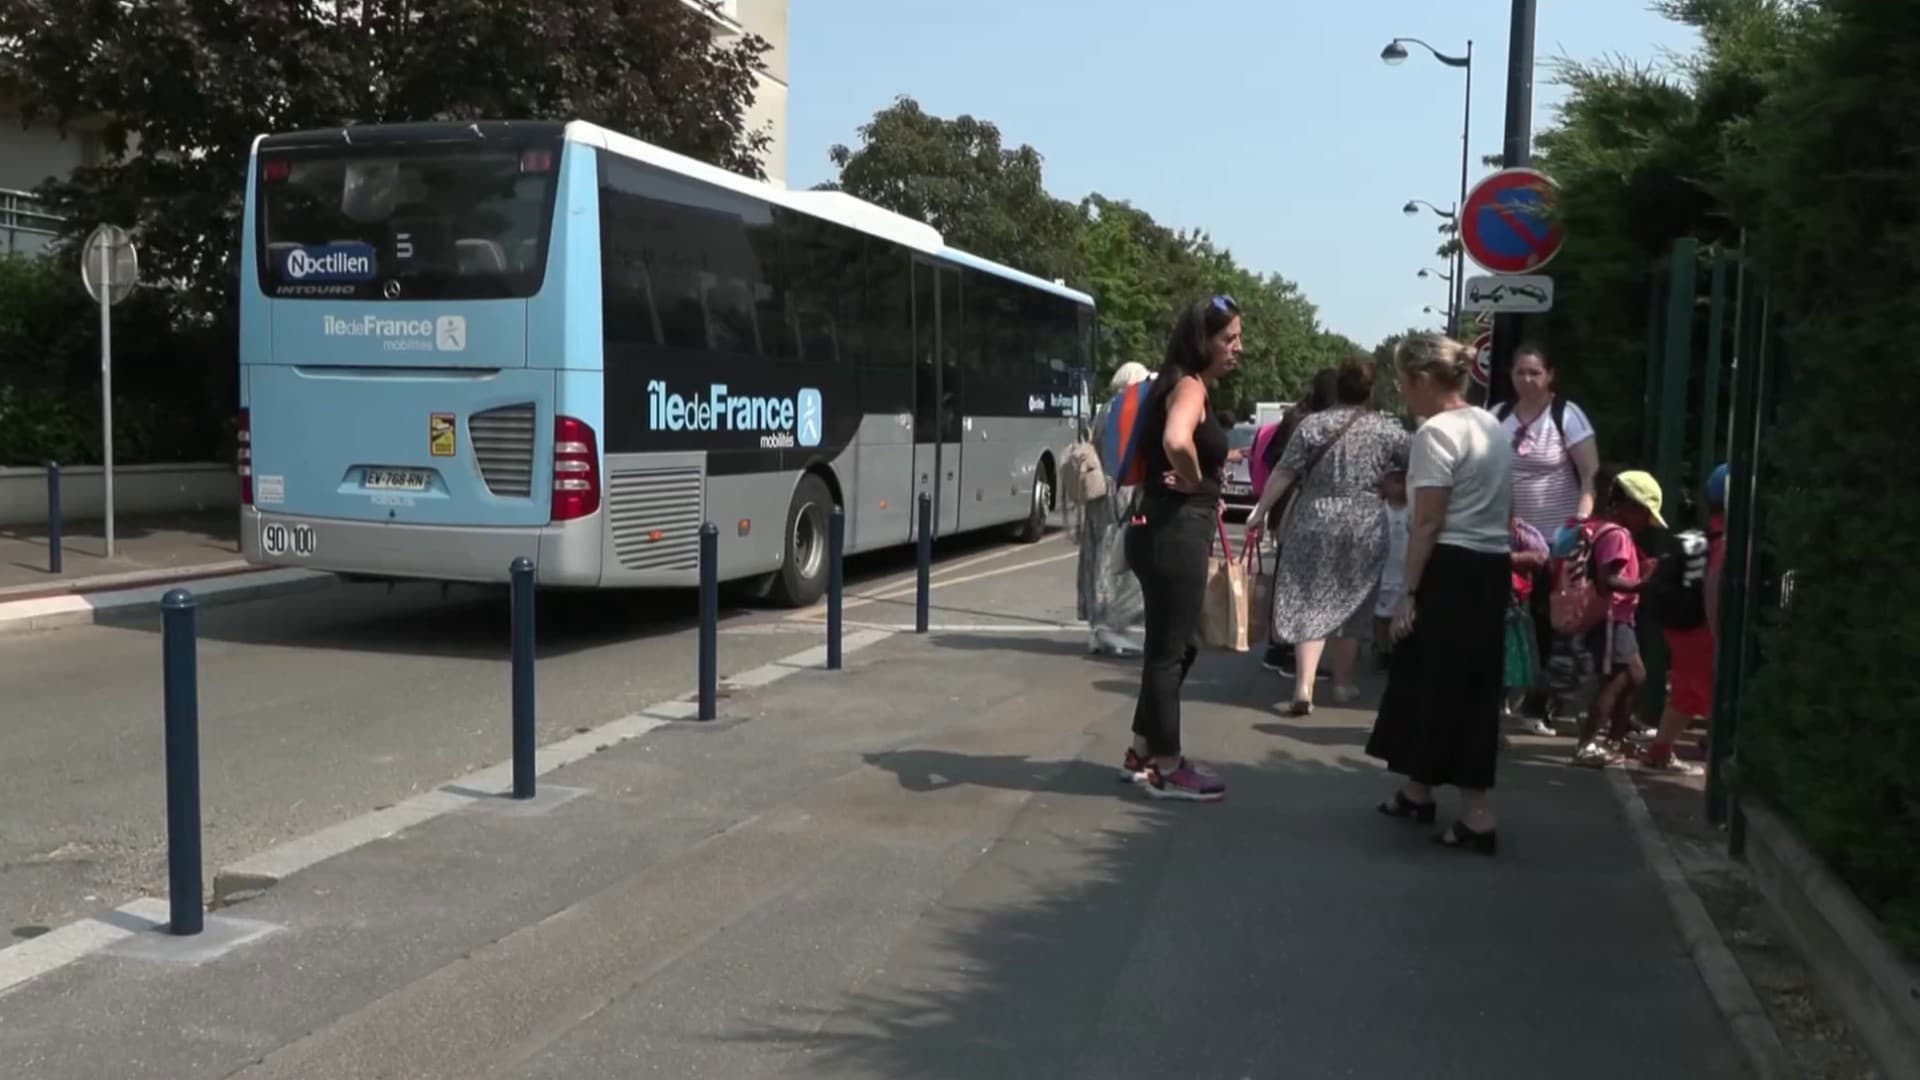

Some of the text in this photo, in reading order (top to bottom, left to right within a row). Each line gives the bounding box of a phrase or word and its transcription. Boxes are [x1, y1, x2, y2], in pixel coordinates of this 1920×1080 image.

[287, 249, 368, 278] Noctilien
[276, 285, 355, 295] INTOURO
[267, 526, 285, 552] 90
[292, 527, 314, 553] 100
